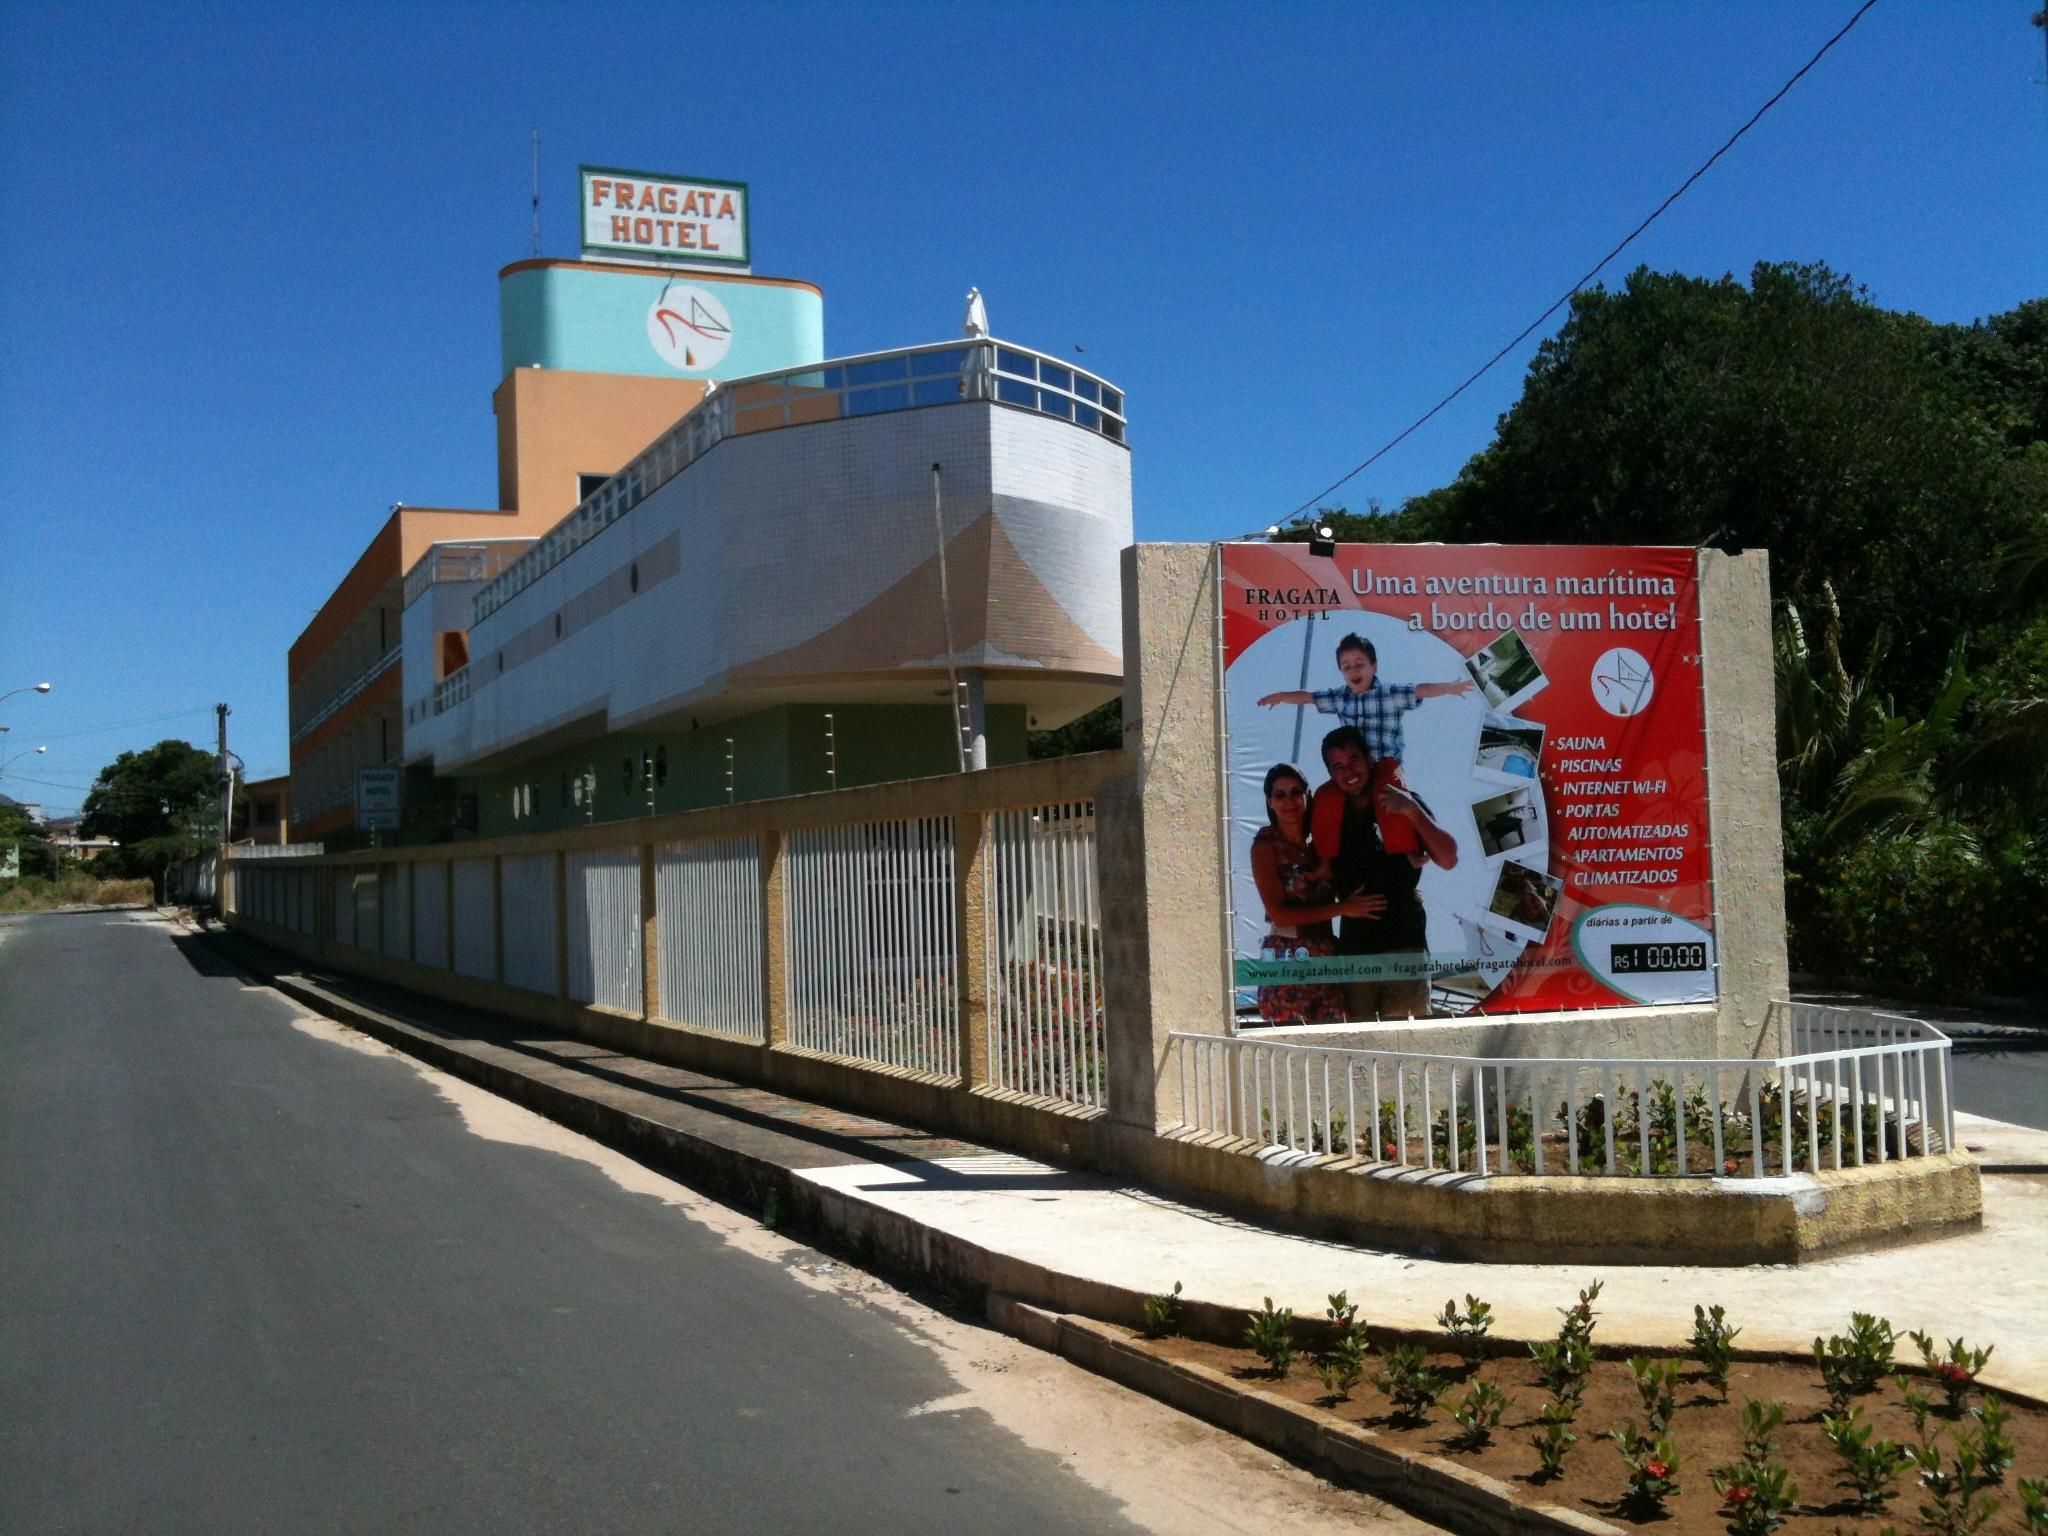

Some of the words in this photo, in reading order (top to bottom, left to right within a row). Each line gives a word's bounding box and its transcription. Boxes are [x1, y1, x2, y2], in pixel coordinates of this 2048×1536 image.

[592, 179, 736, 220] FRAGATA
[610, 214, 720, 251] HOTEL
[1352, 568, 1424, 595] Uma
[1425, 574, 1548, 595] aventura
[1555, 568, 1677, 595] marítima
[1244, 588, 1342, 605] FRAGATA
[1258, 609, 1330, 621] HOTEL
[1408, 611, 1425, 631] a
[1431, 601, 1513, 631] bordo
[1519, 601, 1552, 630] de
[1559, 611, 1601, 630] um
[1609, 601, 1677, 630] hotel
[1556, 736, 1606, 750] SAUNA
[1560, 758, 1622, 773] PISCINAS
[1563, 781, 1631, 796] INTERNET
[1632, 780, 1667, 794] WI-FI
[1565, 803, 1620, 818] PORTAS
[1567, 824, 1689, 841] AUTOMATIZADAS
[1572, 846, 1684, 863] APARTAMENTOS
[1574, 869, 1678, 886] CLIMATIZADOS
[1622, 918, 1629, 926] a
[1631, 916, 1658, 928] partir
[1660, 915, 1673, 925] de
[1614, 953, 1630, 969] R$
